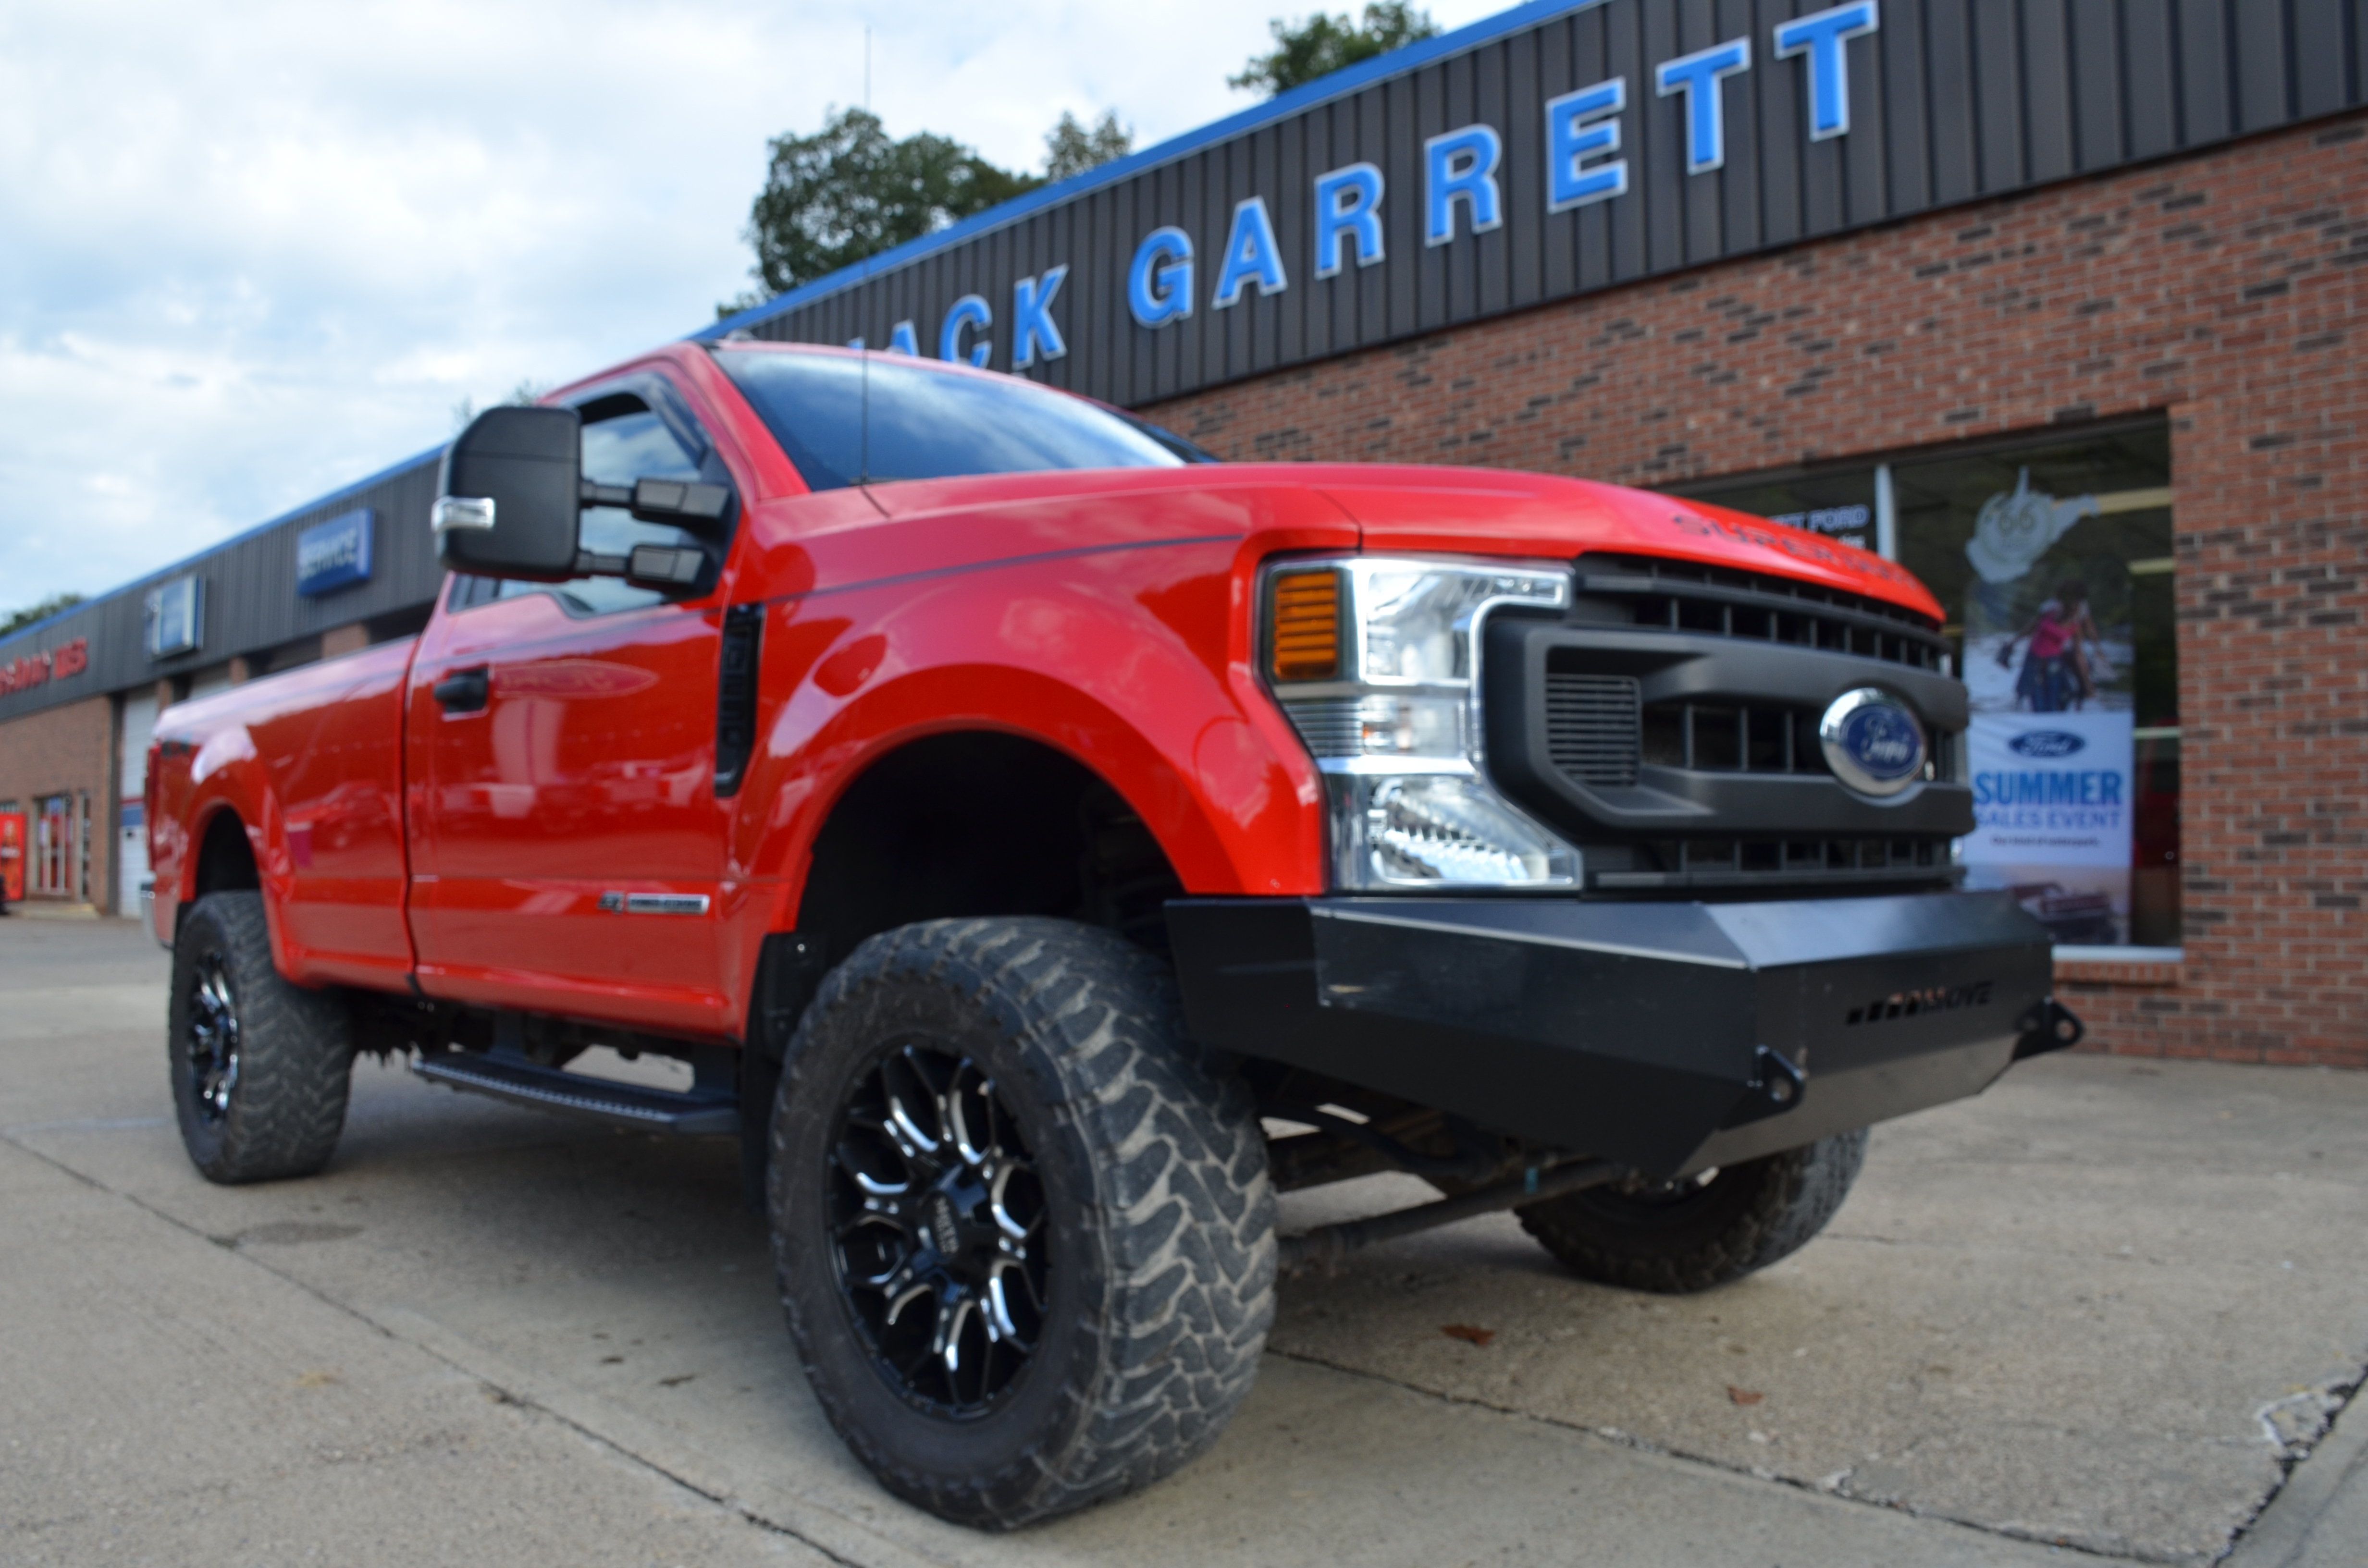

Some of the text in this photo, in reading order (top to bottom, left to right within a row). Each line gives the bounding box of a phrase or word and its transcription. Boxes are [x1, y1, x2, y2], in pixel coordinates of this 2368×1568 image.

[847, 0, 1879, 371] CK GARRETT
[1808, 505, 1869, 532] FORD
[1974, 771, 2122, 806] SUMMER
[1974, 810, 2121, 828] SALES EVENT
